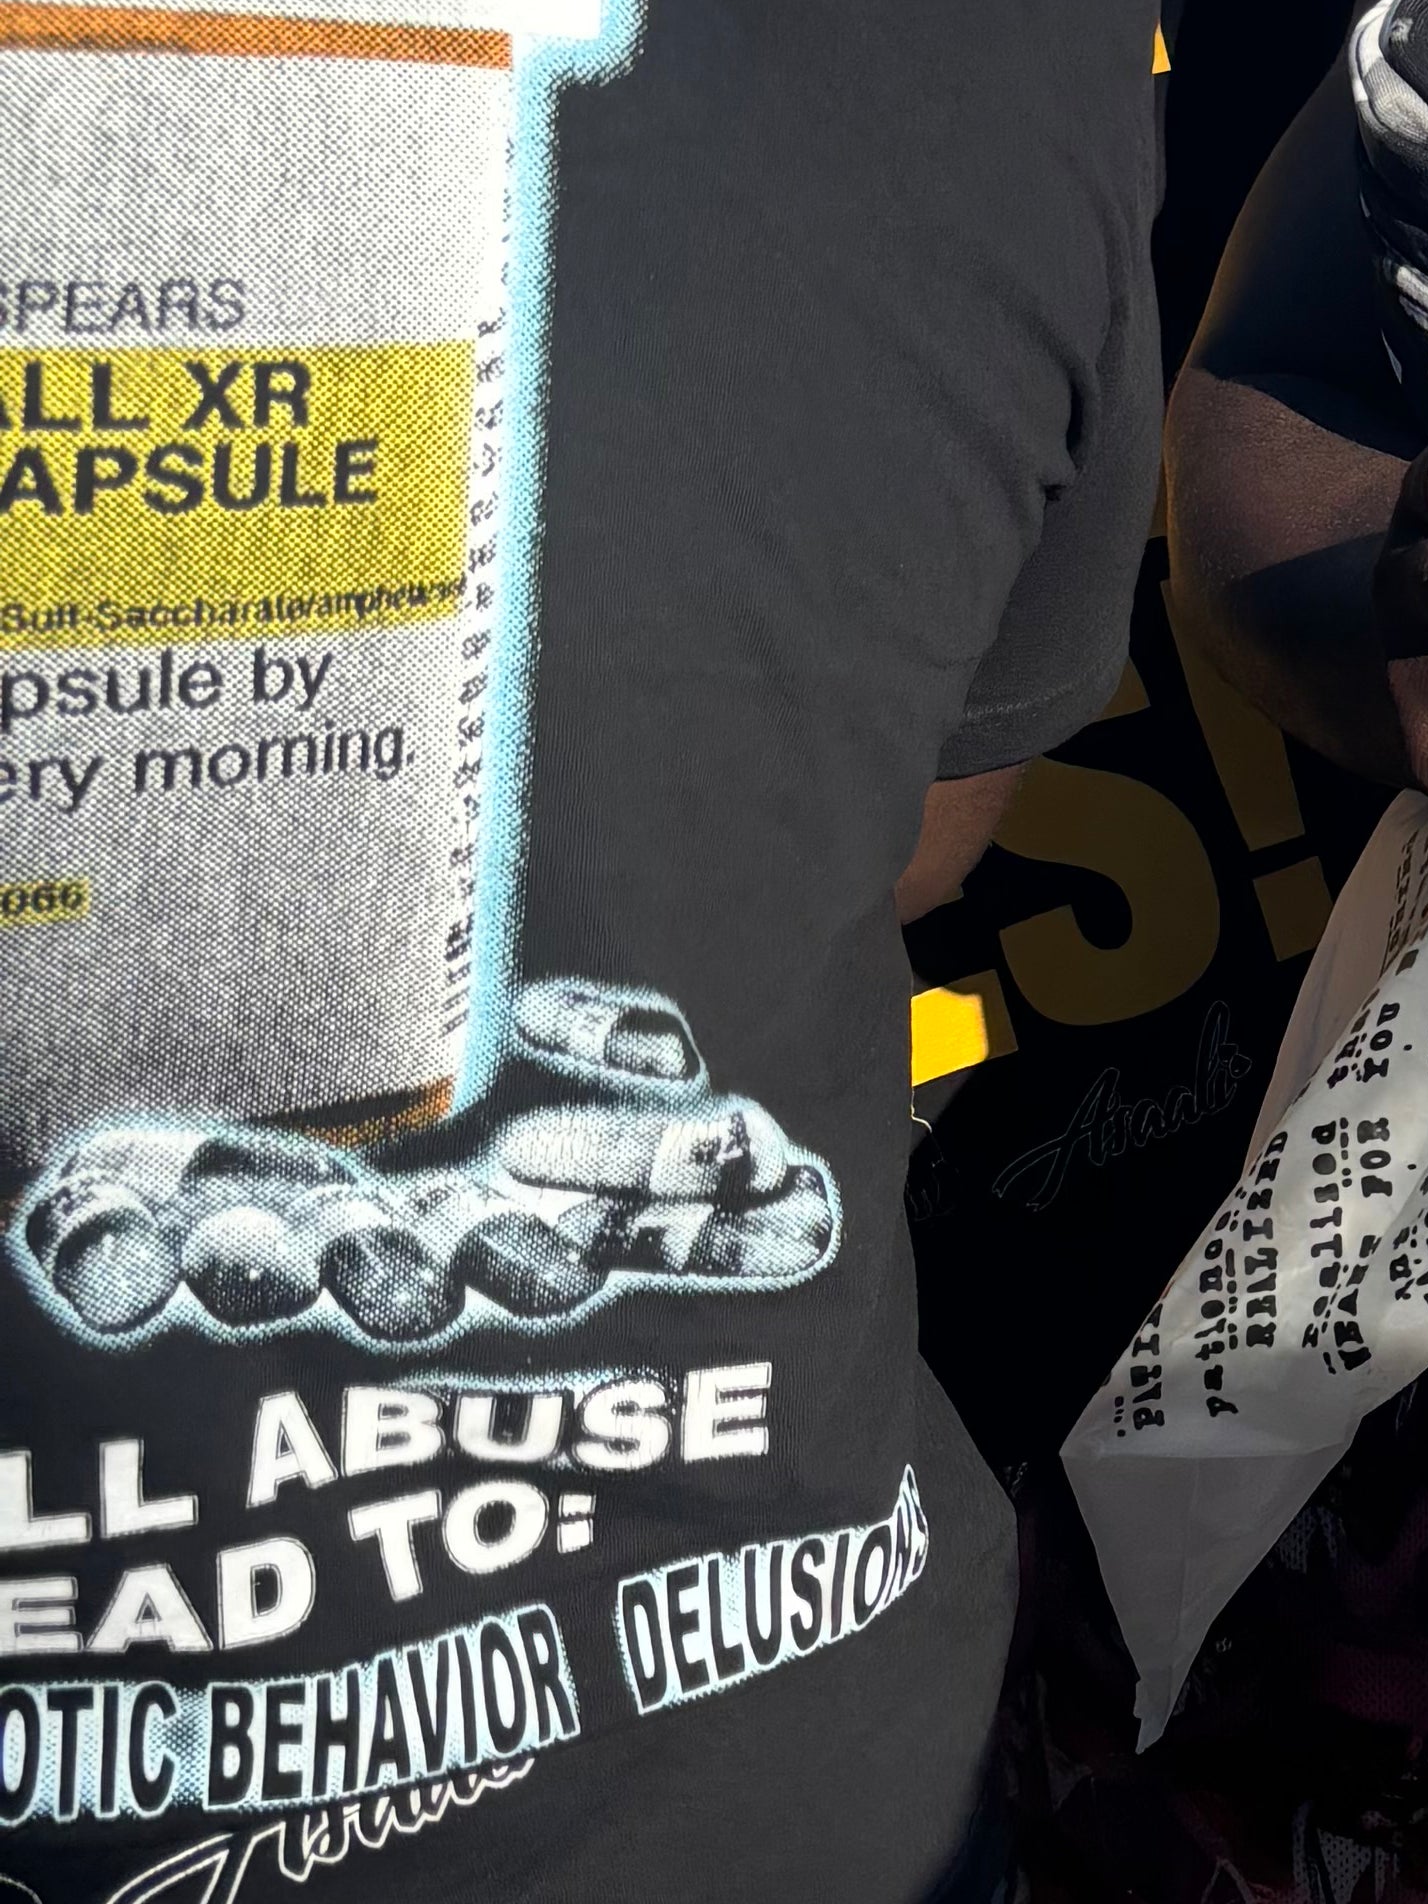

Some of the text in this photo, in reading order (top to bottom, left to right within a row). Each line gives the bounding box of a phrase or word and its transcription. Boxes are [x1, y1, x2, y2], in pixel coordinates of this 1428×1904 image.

[0, 277, 248, 335] PEARS
[0, 358, 314, 433] LL XR
[252, 645, 333, 712] by
[134, 719, 416, 796] morning.
[1362, 1002, 1401, 1083] YOU
[247, 1362, 773, 1509] ABUSE
[347, 1478, 597, 1602] TO:
[202, 1603, 581, 1814] BEHAVIOR
